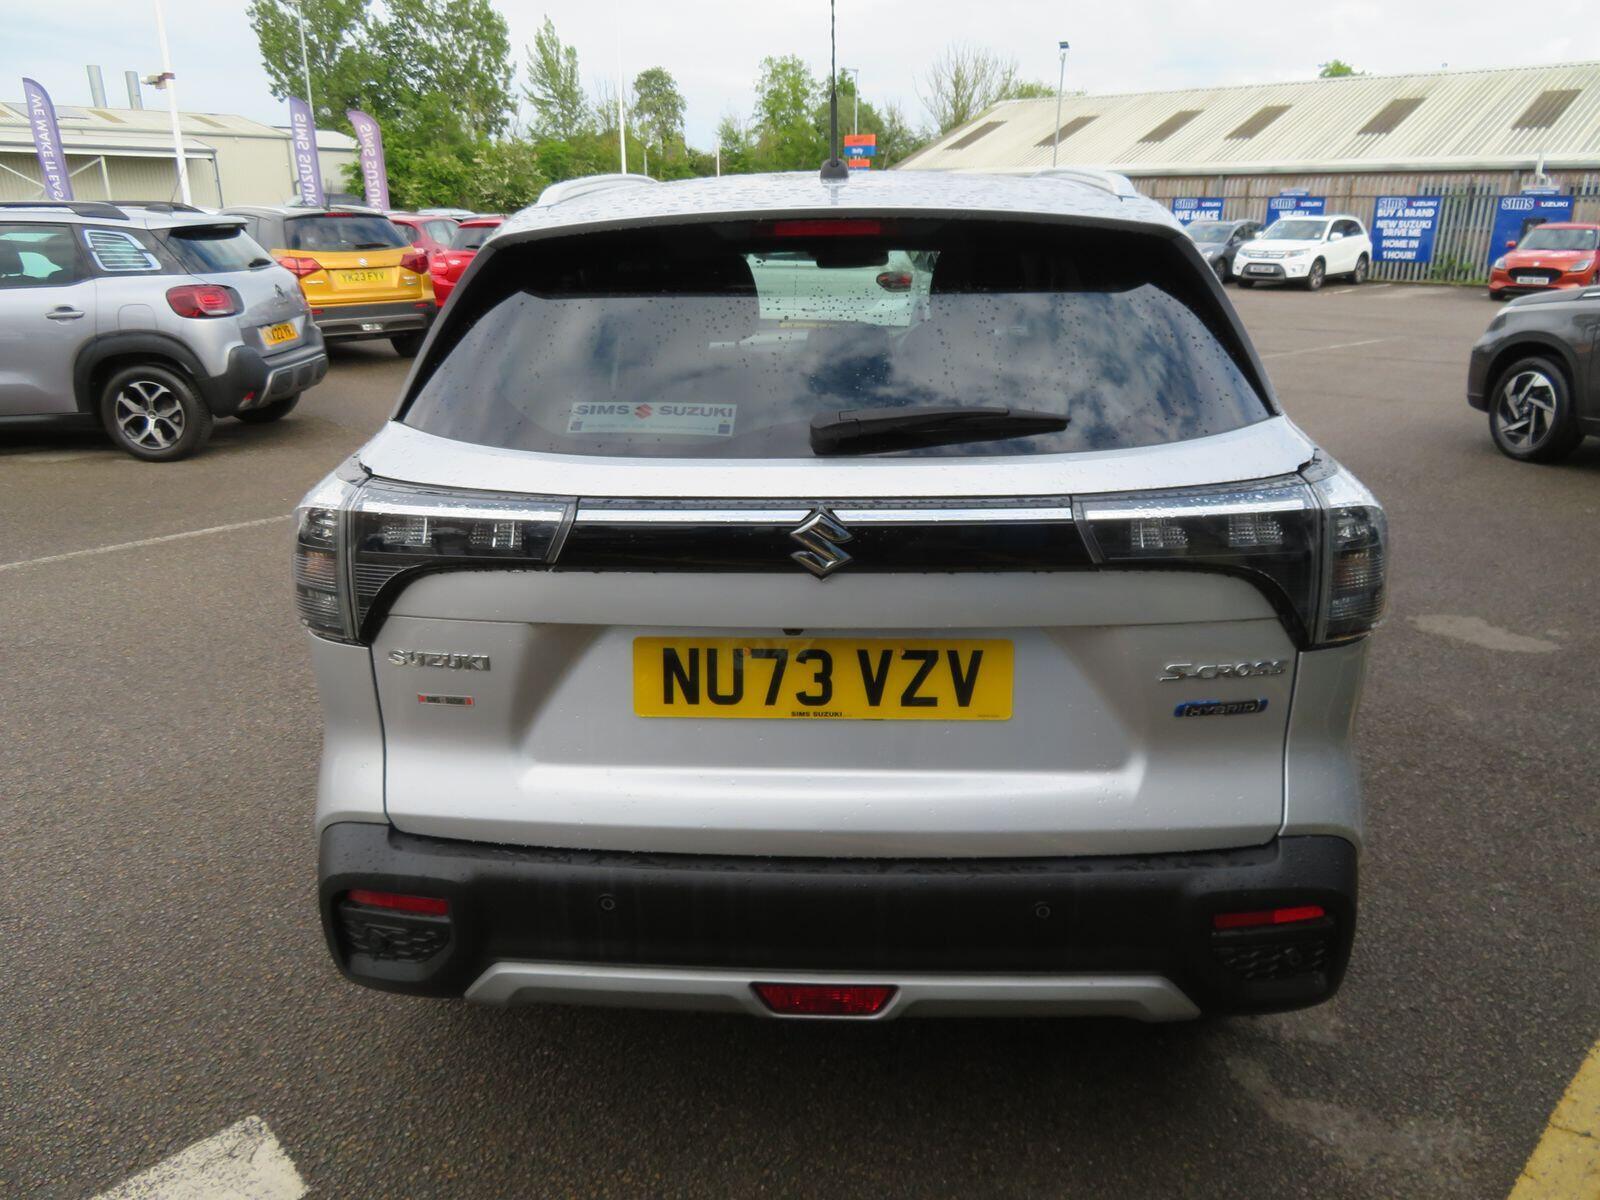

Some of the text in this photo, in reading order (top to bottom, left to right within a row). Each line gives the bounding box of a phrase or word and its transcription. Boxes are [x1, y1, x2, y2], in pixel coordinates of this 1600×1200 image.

[1175, 210, 1219, 221] WE MAKE
[1377, 208, 1435, 217] BUY A BRAND
[1376, 220, 1432, 229] NEW SUZUKI
[1382, 228, 1421, 237] DRIVE ME
[1382, 239, 1419, 248] HOME IN
[574, 404, 733, 418] SIMS SUZUKI
[388, 650, 490, 671] SUZUKI
[662, 647, 984, 707] NU73 VZV
[1187, 702, 1257, 716] HYBRID
